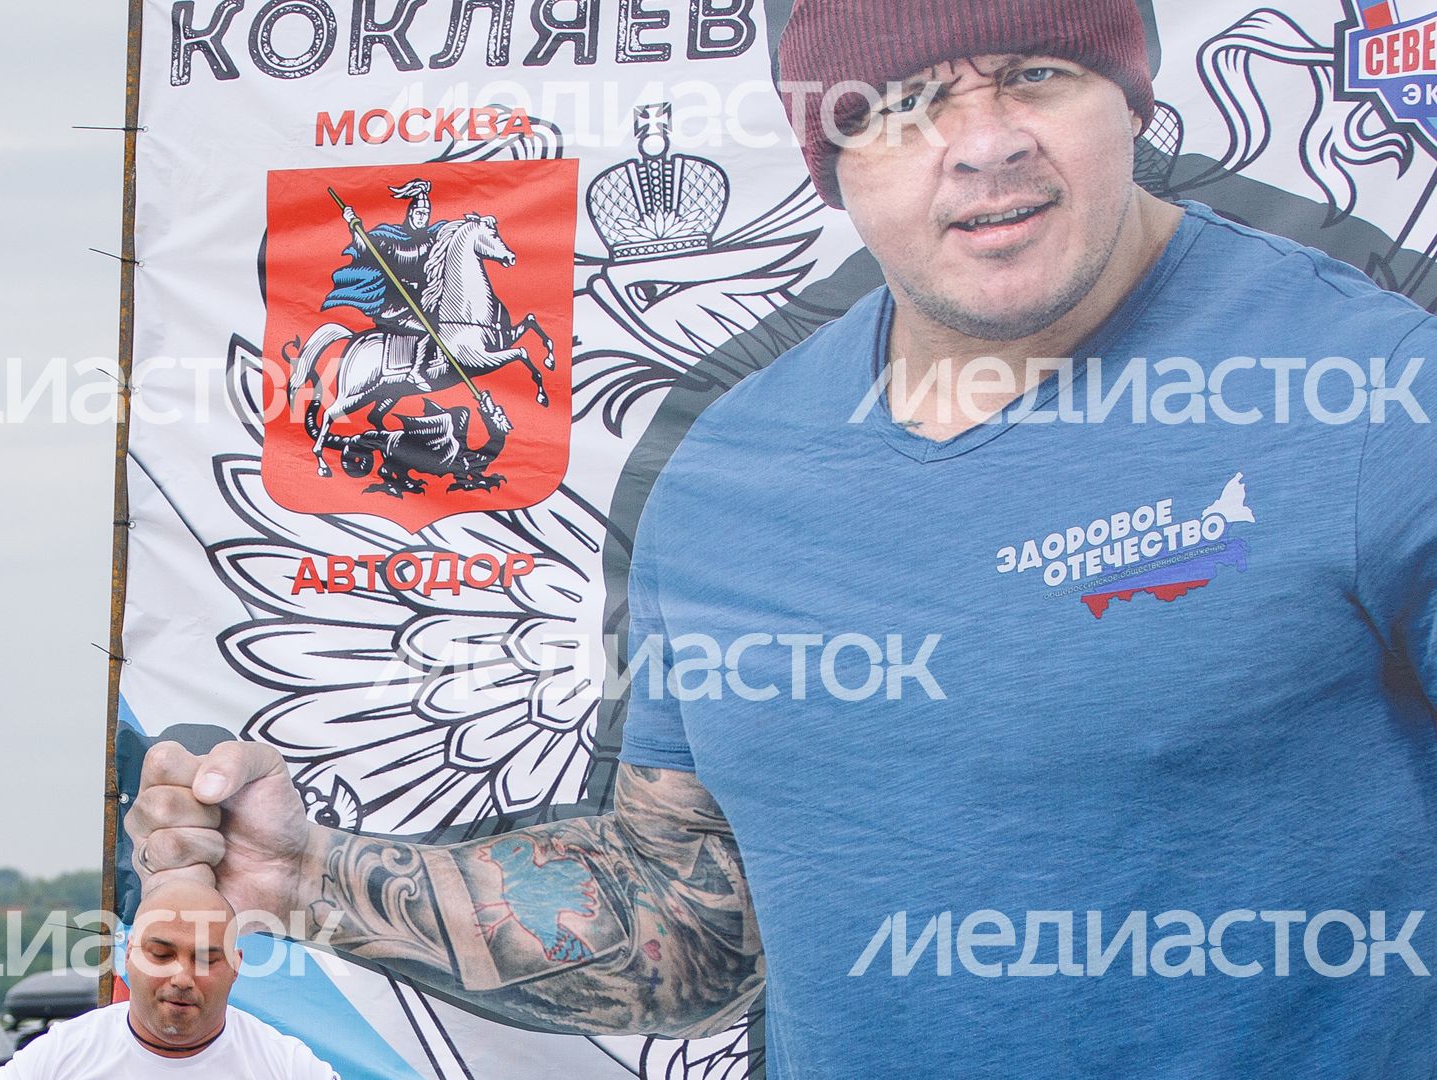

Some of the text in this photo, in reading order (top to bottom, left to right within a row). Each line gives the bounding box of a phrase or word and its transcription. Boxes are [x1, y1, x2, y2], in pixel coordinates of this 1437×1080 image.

[170, 0, 757, 86] КОКЛЯЕВ
[315, 107, 535, 146] МОСКВА
[996, 498, 1173, 574] ЗДОРОВОЕ
[1043, 515, 1225, 587] ОТЕЧЕСТВО
[291, 552, 535, 596] АВТОДОР
